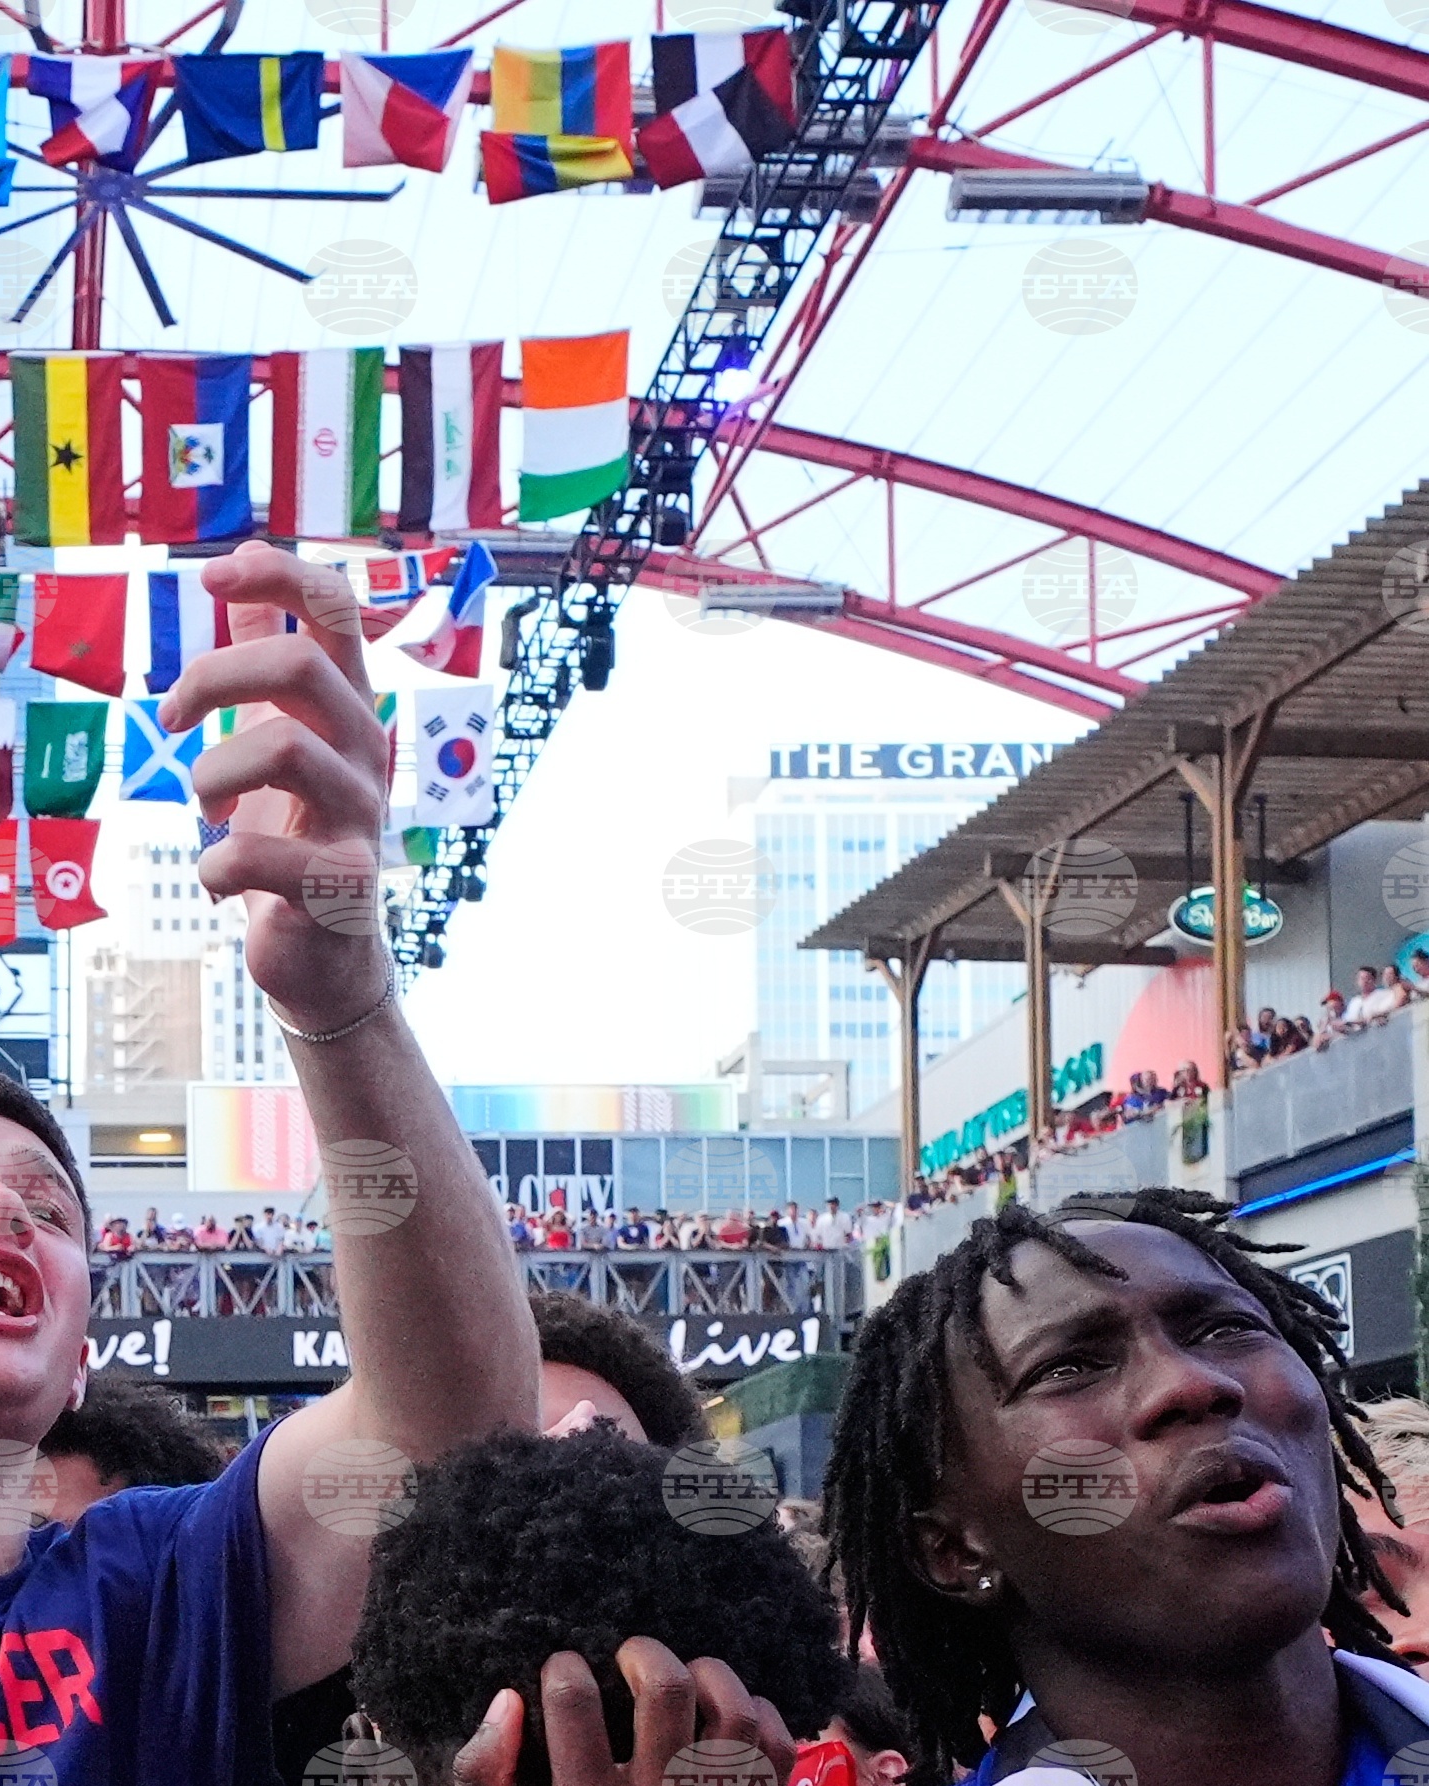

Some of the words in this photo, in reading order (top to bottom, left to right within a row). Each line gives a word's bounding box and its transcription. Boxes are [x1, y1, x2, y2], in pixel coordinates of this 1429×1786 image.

[771, 743, 882, 777] THE
[897, 743, 1054, 777] GRAN
[84, 1319, 171, 1375] ve!
[293, 1331, 348, 1366] KA
